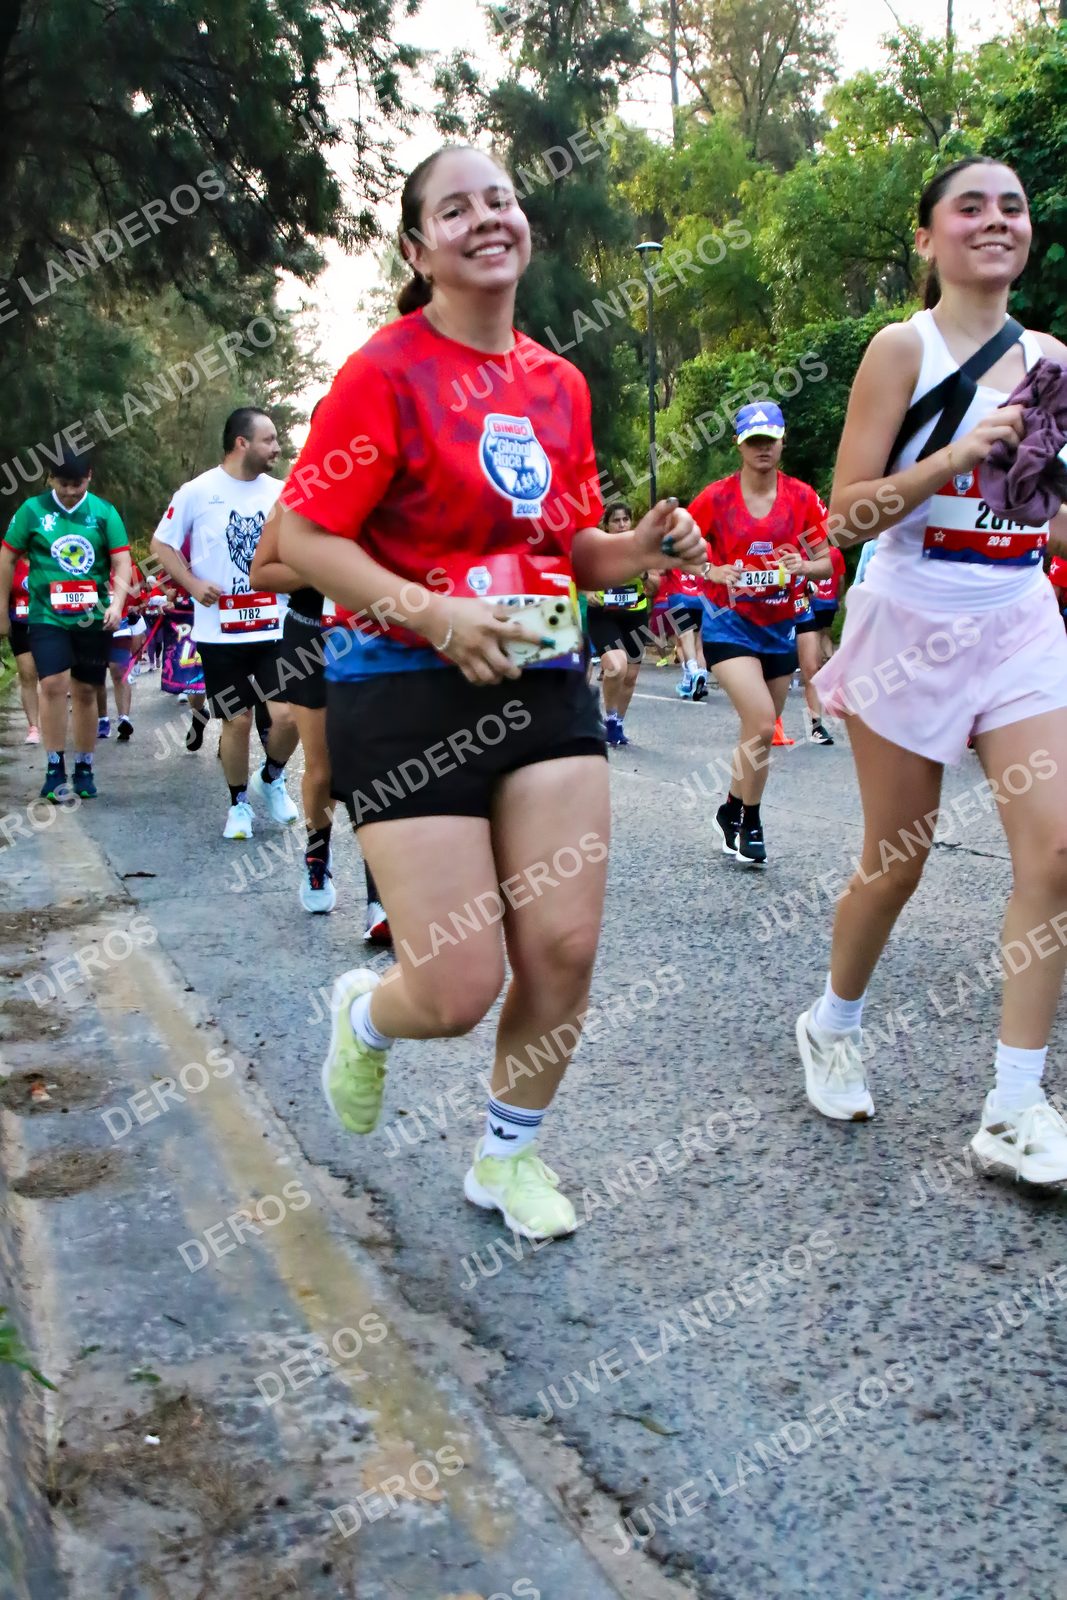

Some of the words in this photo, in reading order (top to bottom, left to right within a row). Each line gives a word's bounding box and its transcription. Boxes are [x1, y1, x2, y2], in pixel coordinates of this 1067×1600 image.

[493, 423, 528, 435] BIMBO
[498, 438, 530, 456] Global
[493, 451, 522, 467] Race
[746, 571, 774, 586] 3426
[65, 593, 85, 603] 1902
[238, 608, 261, 620] 1782
